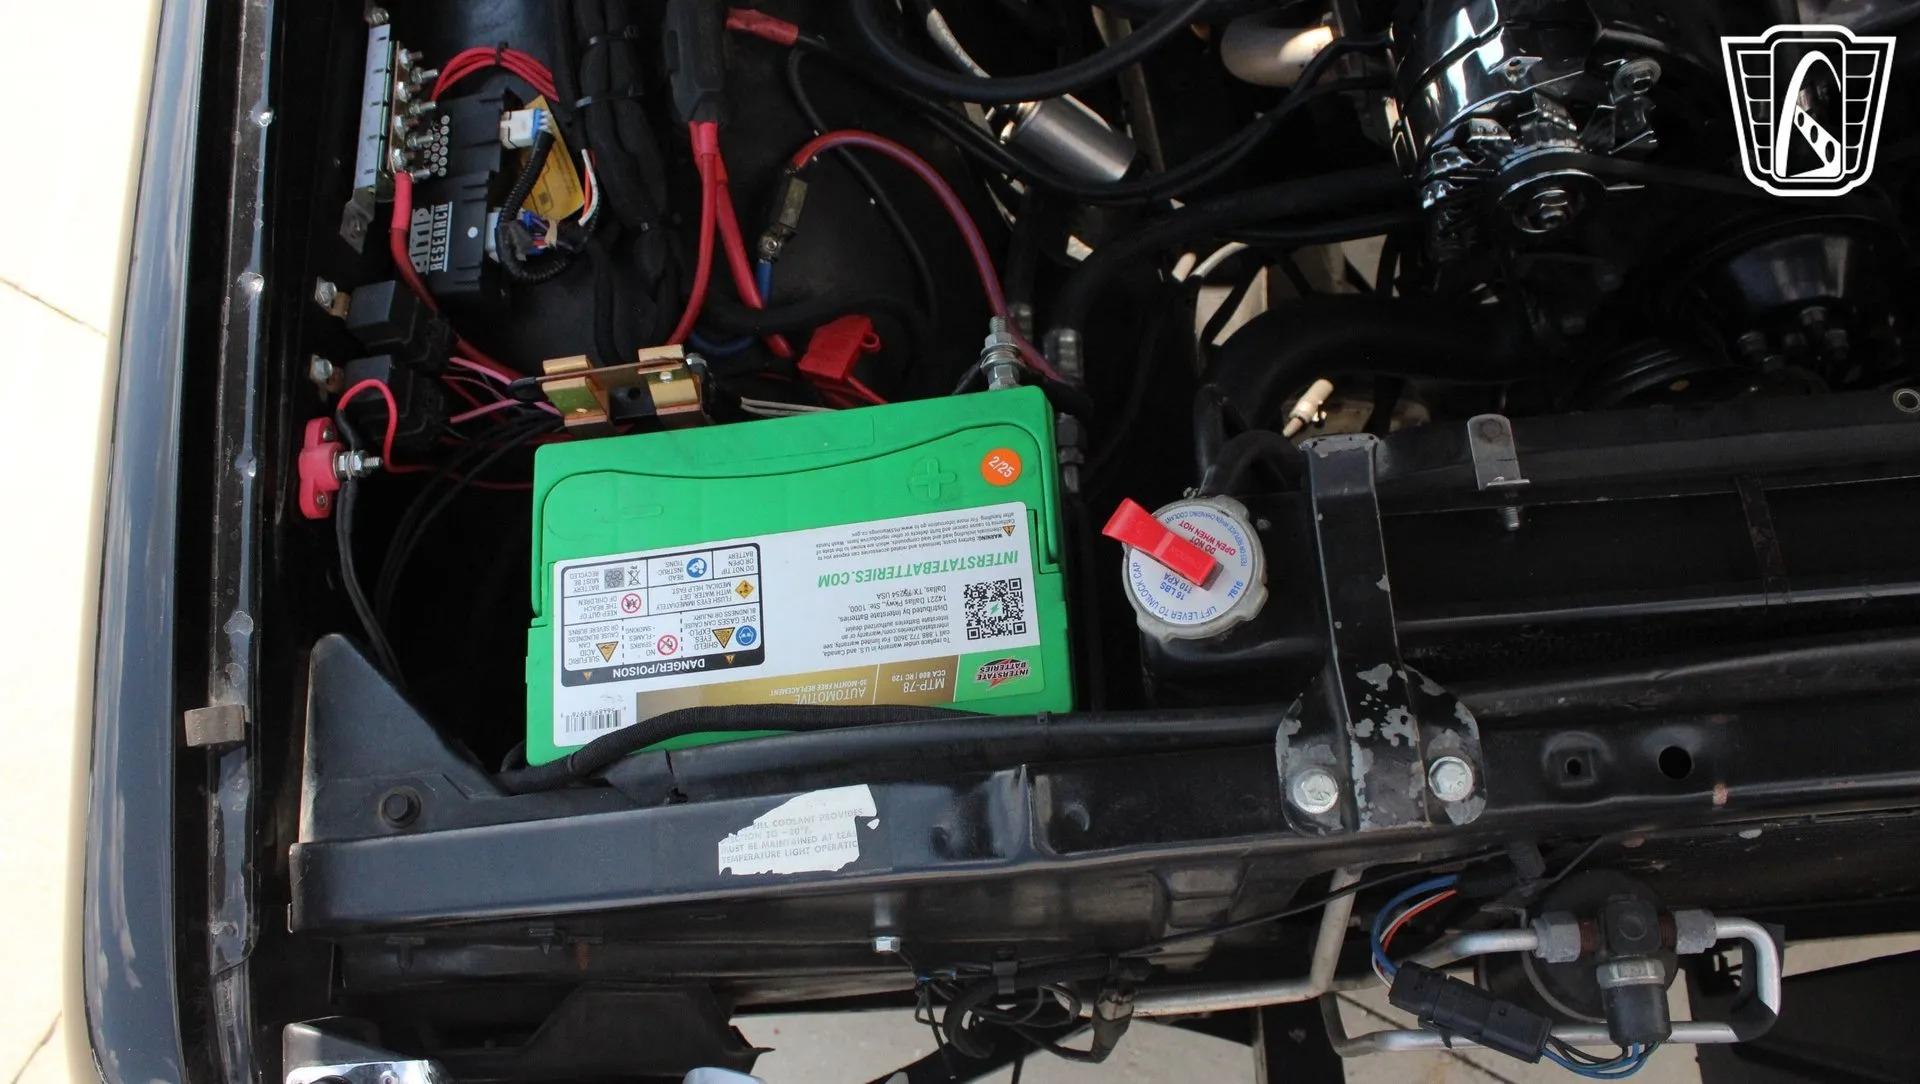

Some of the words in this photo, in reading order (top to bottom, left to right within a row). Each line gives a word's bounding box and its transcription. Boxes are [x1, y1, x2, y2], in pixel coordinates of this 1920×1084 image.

[430, 204, 449, 272] RESEARCH
[989, 456, 1014, 477] 2/25
[1164, 511, 1188, 524] COOLANT
[1178, 520, 1195, 532] HOT
[1194, 528, 1216, 544] WHEN
[1189, 536, 1206, 549] NOT
[1216, 540, 1236, 556] OPEN
[1204, 544, 1217, 555] DO
[817, 550, 1019, 588] INTERSTATEBATTERIES.COM
[1132, 562, 1142, 579] CAP
[705, 581, 731, 590] MEDICAL
[1164, 573, 1180, 587] KPA
[573, 584, 599, 593] BATTERY
[1160, 582, 1177, 597] LBS
[1179, 583, 1192, 594] 110
[712, 595, 732, 604] FLUSH
[927, 595, 947, 603] 14221
[1136, 581, 1160, 610] UNLOCK
[1175, 590, 1185, 600] 16
[656, 600, 695, 610] IMMEDIATELY
[904, 597, 924, 606] Dallas
[724, 608, 756, 617] BLINDNESS
[870, 609, 901, 619] Interstate
[903, 607, 910, 615] by
[912, 604, 947, 614] Distributed
[1158, 606, 1169, 617] TO
[1201, 606, 1217, 620] LIFT
[718, 617, 739, 625] GASES
[838, 613, 868, 623] Batteries,
[1170, 610, 1199, 621] LEVER
[625, 625, 652, 634] SMOKING
[688, 627, 711, 637] EXPLO-
[568, 634, 599, 643] BLINDNESS
[920, 637, 942, 646] replace
[694, 641, 718, 650] SHIELD
[878, 641, 902, 651] warranty
[568, 655, 599, 665] SULFURIC
[612, 658, 705, 678] DANGER/POISON
[932, 669, 946, 677] CCA
[979, 662, 1026, 673] BATTERIES
[975, 668, 1029, 680] INTERSTATE
[770, 684, 816, 696] REPLACEMENT
[903, 677, 945, 693] MTP-78
[794, 687, 867, 705] AUTOMOTIVE
[772, 817, 816, 828] COOLANT
[721, 851, 781, 863] TEMPERATURE
[785, 849, 810, 857] LIGHT
